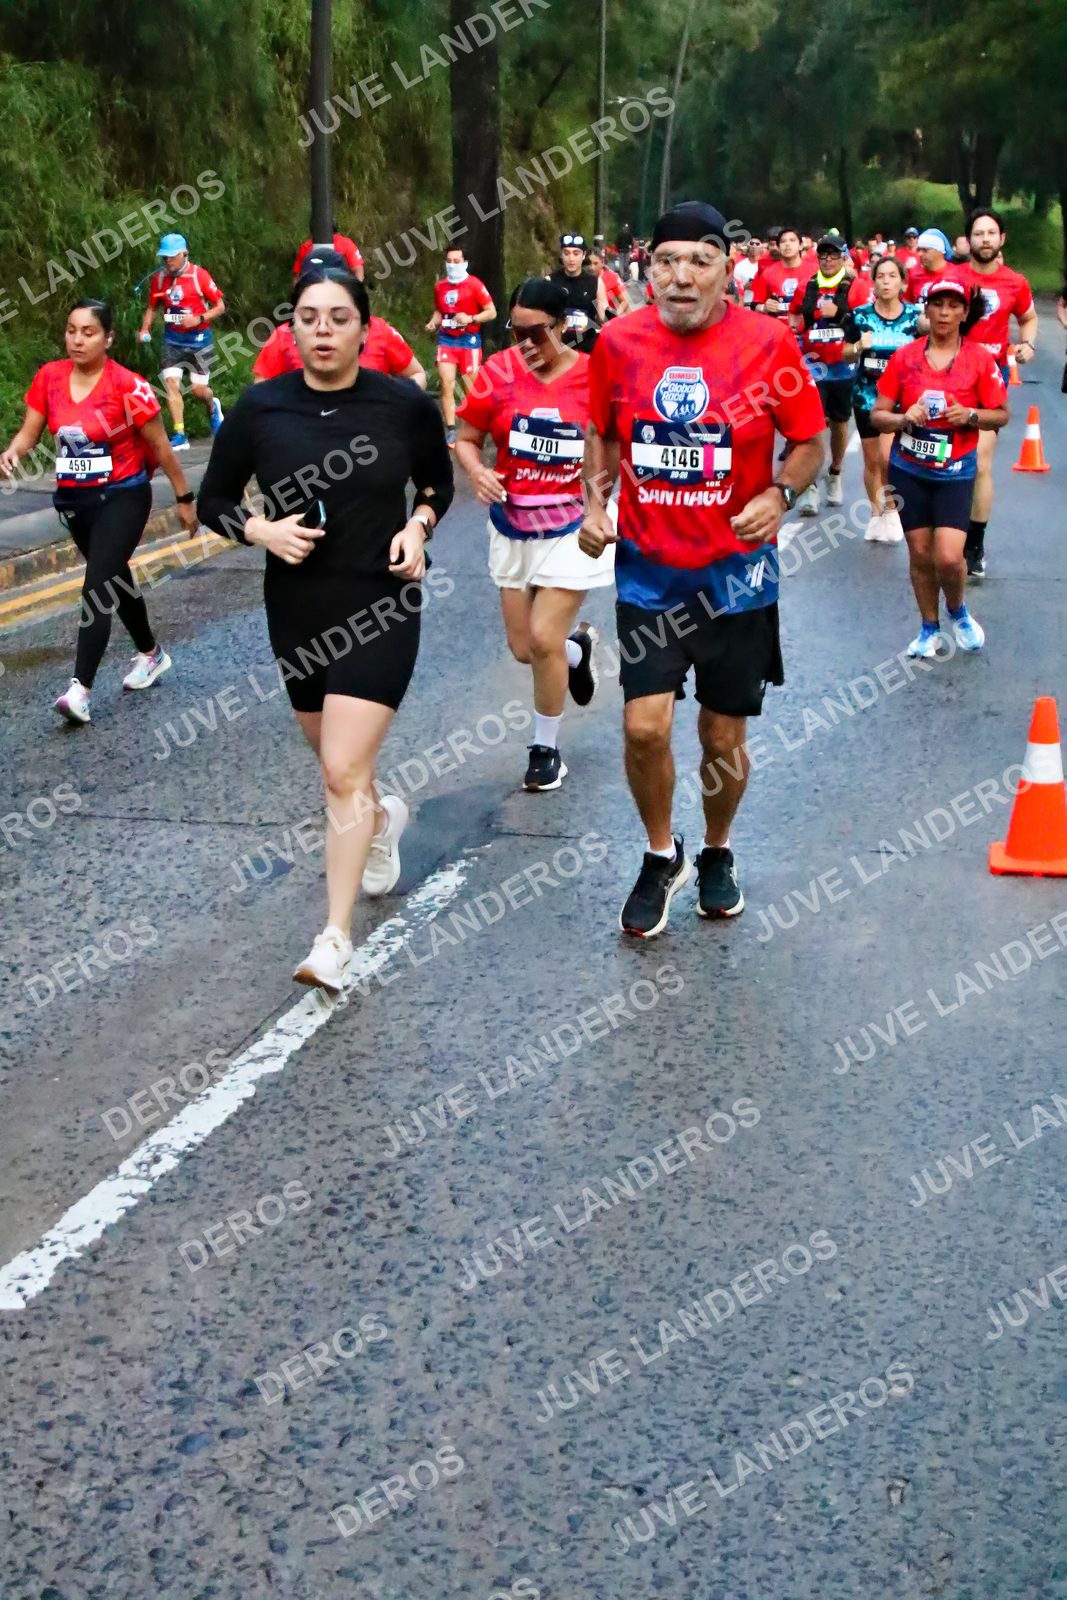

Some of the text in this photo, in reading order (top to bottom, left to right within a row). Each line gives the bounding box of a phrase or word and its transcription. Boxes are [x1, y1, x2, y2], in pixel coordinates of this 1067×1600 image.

[818, 328, 835, 338] 3903
[876, 359, 889, 368] 56
[669, 372, 698, 380] BIMBO
[667, 382, 697, 393] Global
[661, 391, 685, 402] Race
[531, 437, 559, 455] 4701
[910, 436, 936, 454] 3999
[661, 447, 700, 469] 4146
[68, 459, 92, 472] 4597
